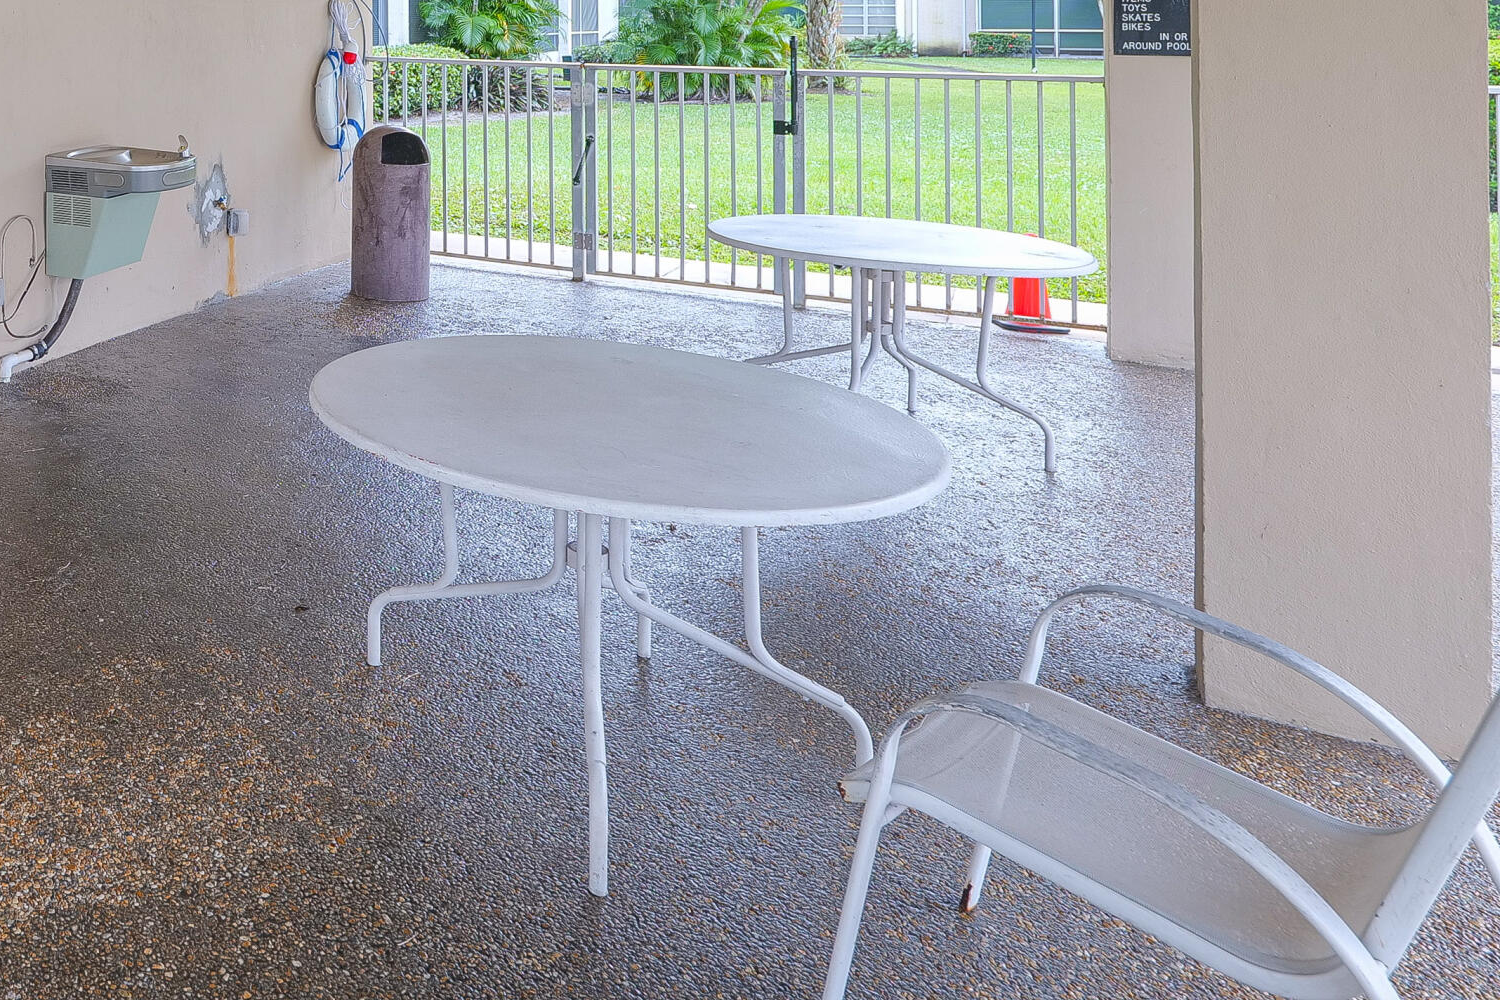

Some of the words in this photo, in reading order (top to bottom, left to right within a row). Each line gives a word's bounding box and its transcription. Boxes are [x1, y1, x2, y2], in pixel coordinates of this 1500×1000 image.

[1122, 23, 1151, 31] BIKES
[1123, 42, 1162, 50] AROUND
[1167, 42, 1191, 50] POOL
